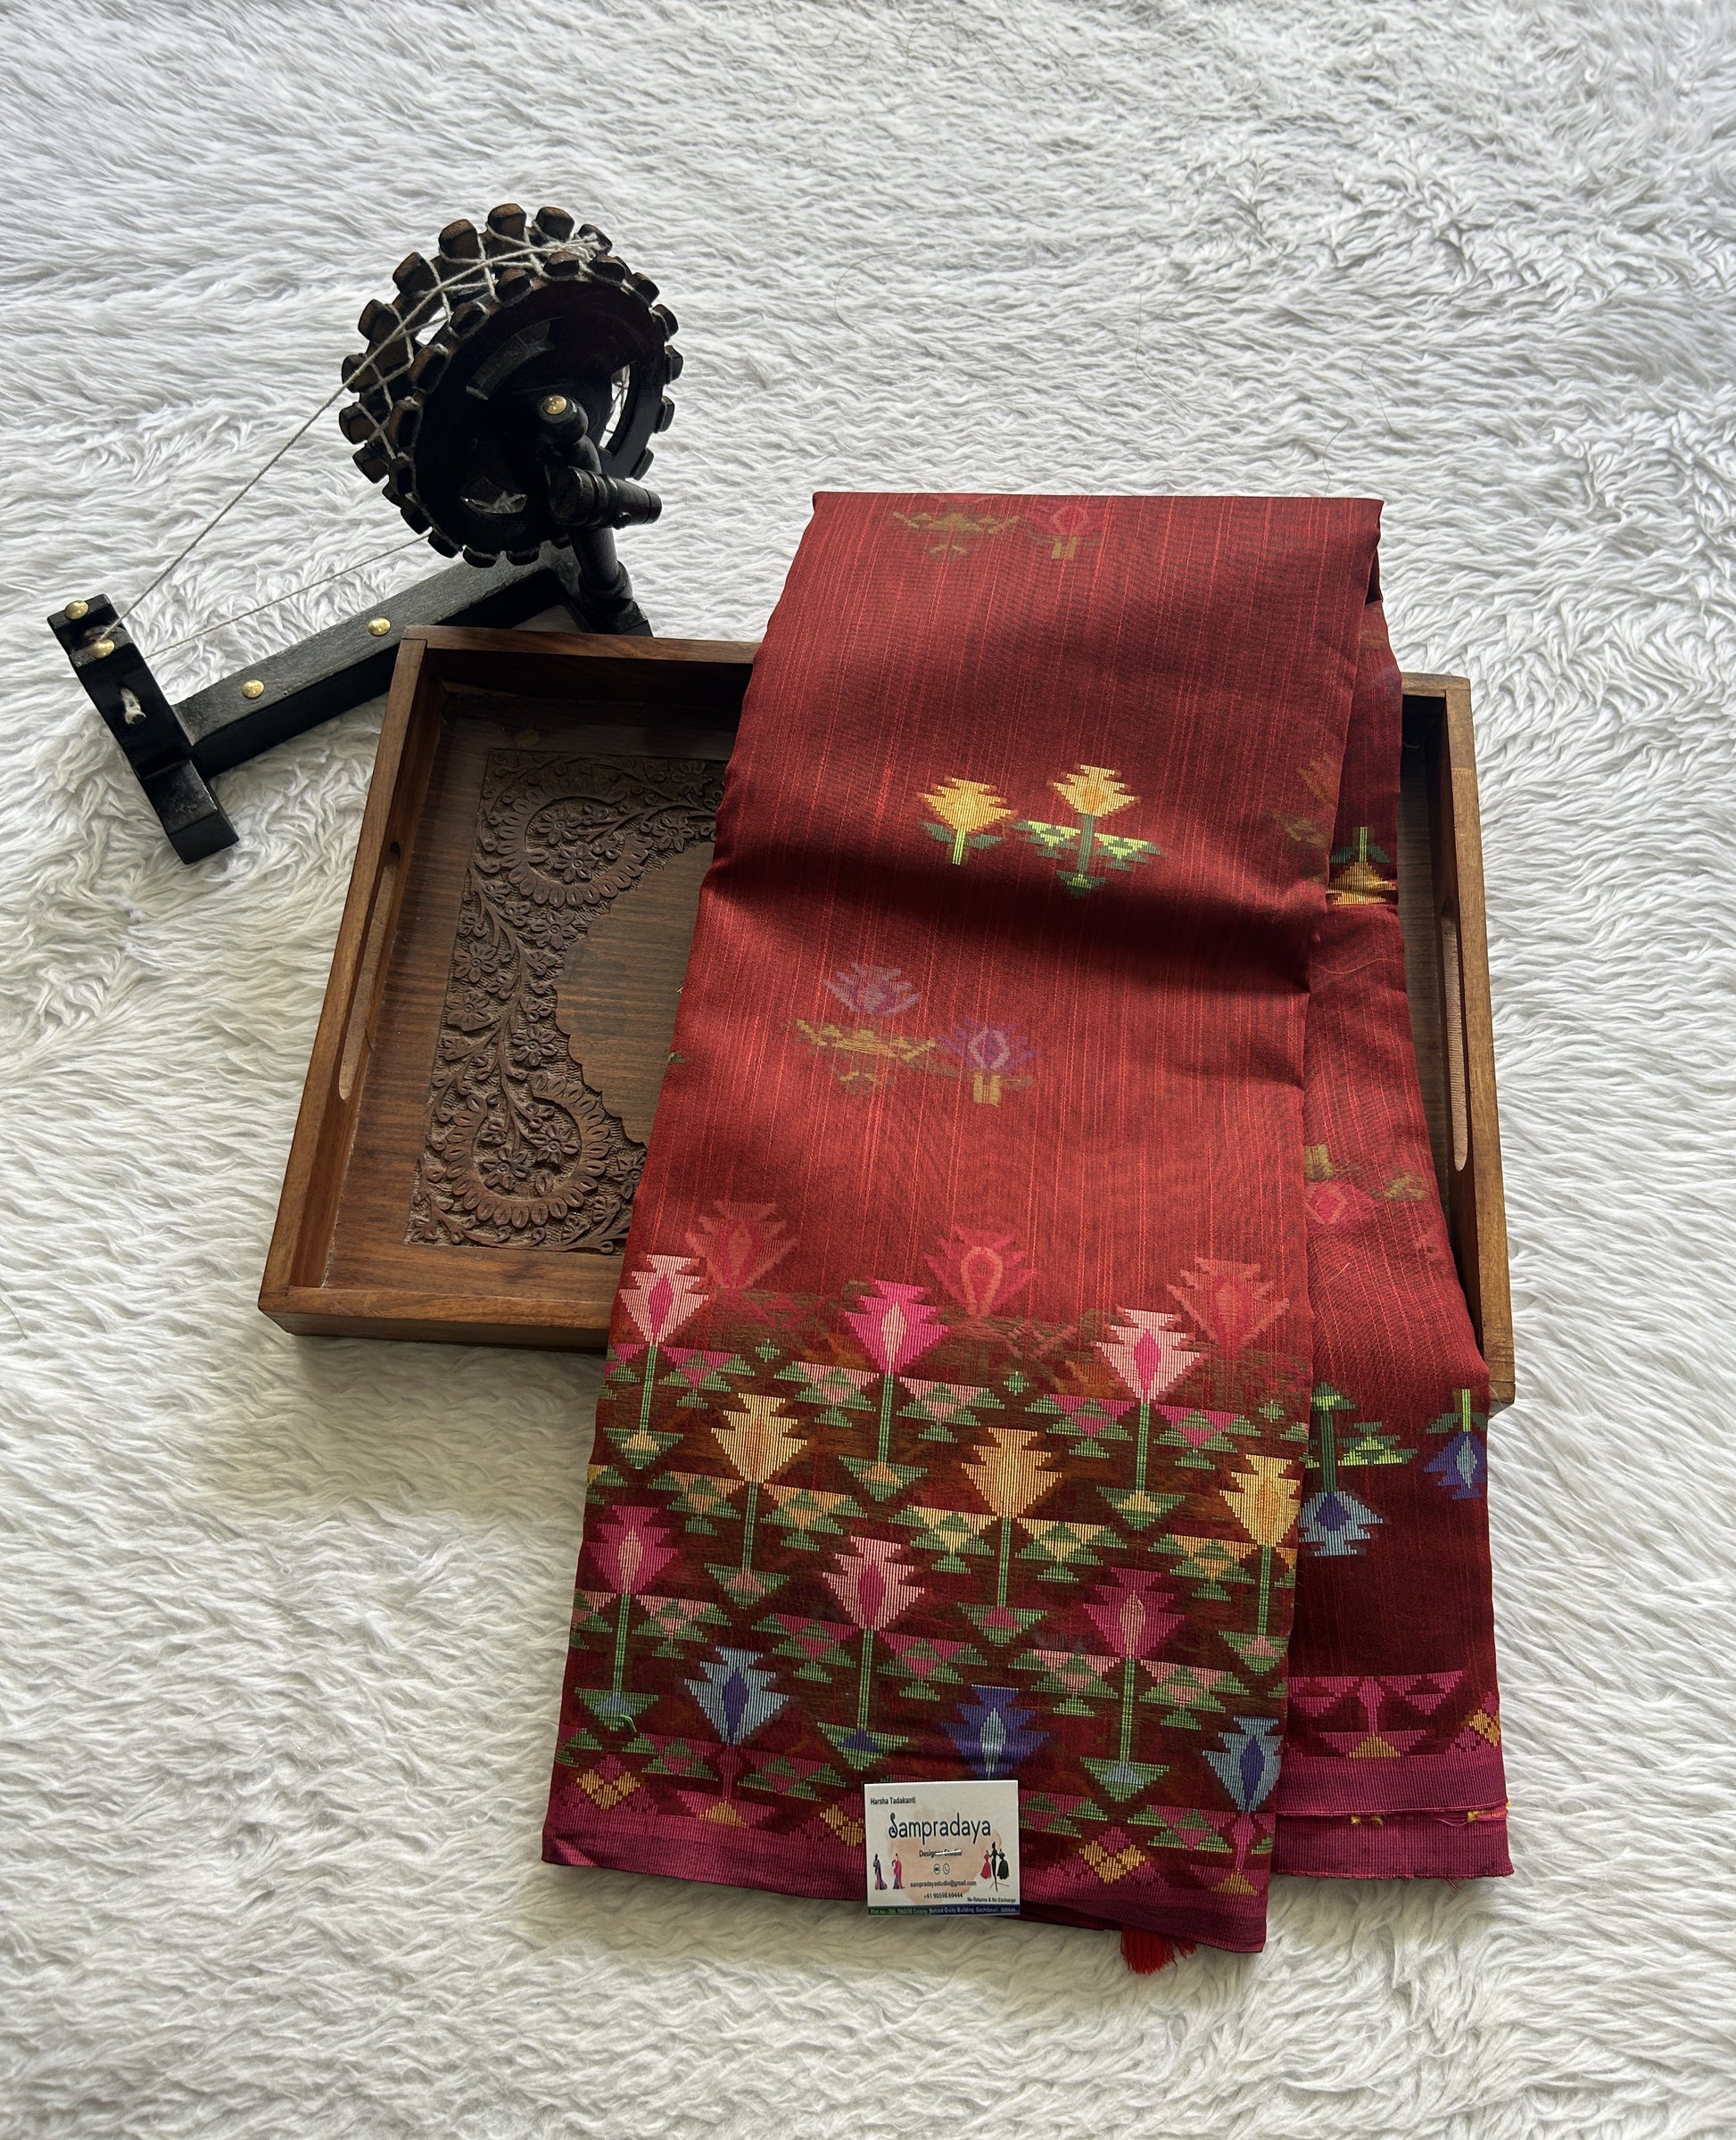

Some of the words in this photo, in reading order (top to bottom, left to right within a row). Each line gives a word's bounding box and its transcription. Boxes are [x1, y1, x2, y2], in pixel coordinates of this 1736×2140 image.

[870, 1797, 889, 1805] Harsha
[889, 1796, 916, 1805] Tadakanti
[889, 1812, 991, 1845] Sampradaya
